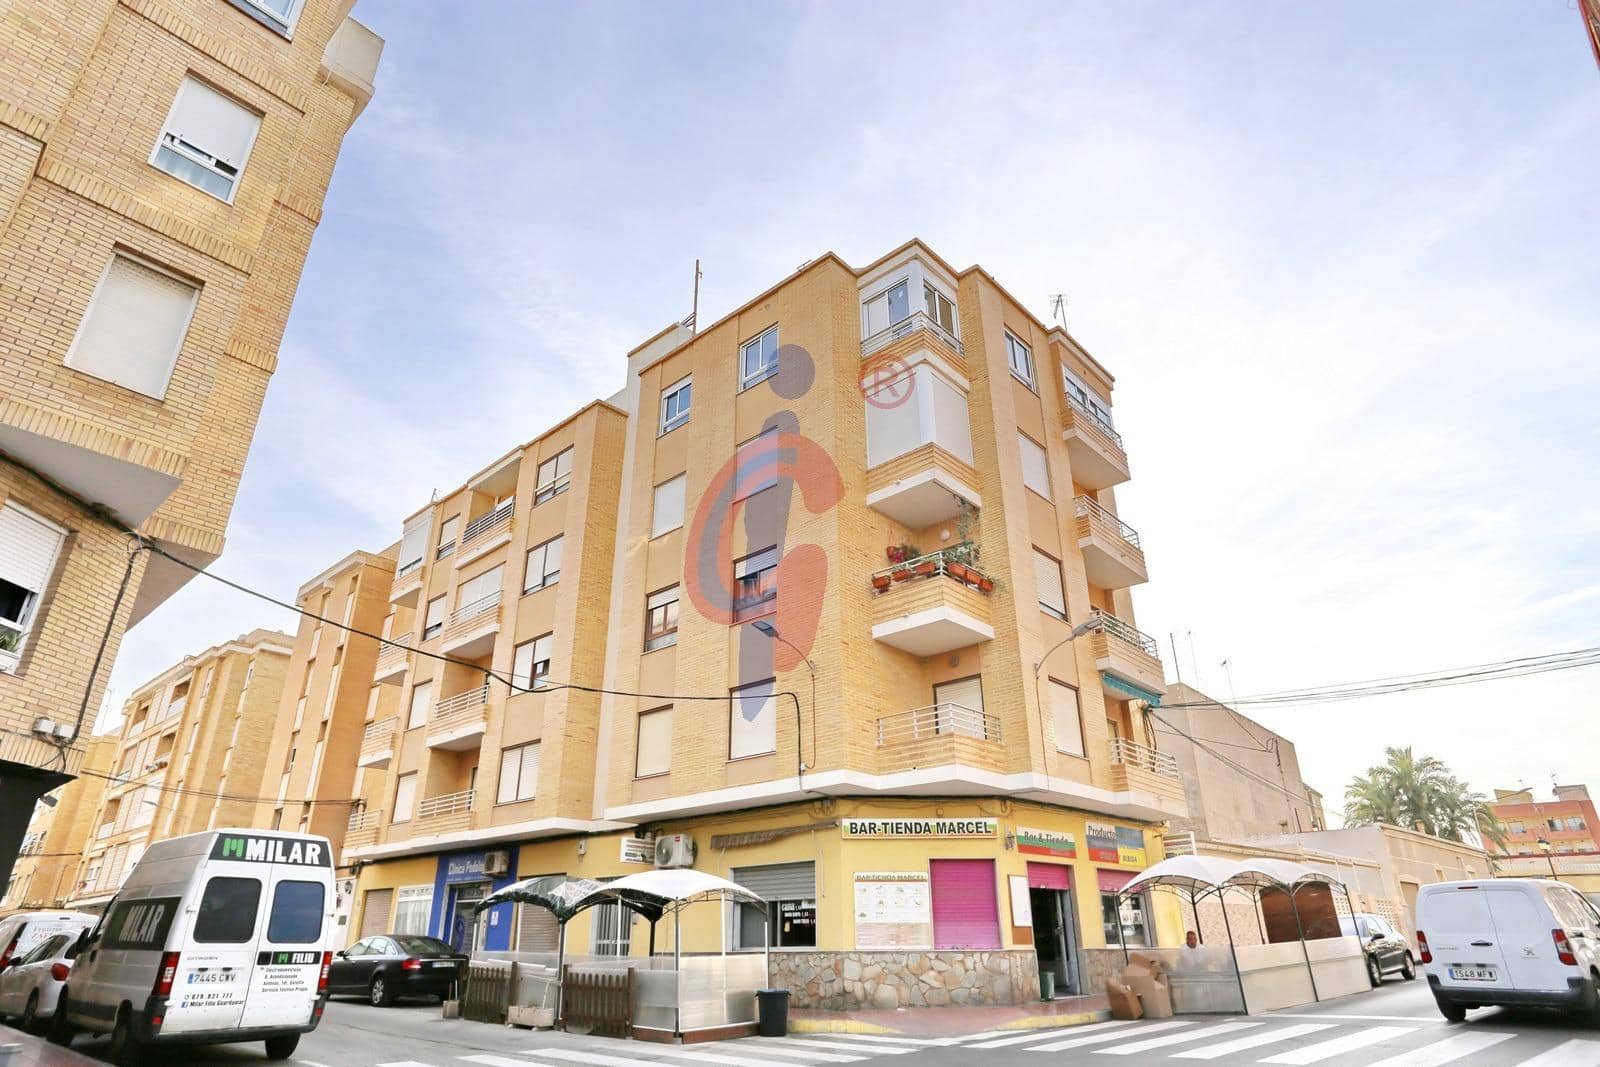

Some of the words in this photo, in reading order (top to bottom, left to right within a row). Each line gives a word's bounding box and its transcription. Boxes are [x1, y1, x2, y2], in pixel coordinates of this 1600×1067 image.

[849, 822, 932, 835] BAR-TIENDA
[936, 821, 992, 834] MARCEL
[245, 838, 321, 865] MILAR
[119, 904, 166, 943] MILAR
[193, 974, 217, 983] 7445
